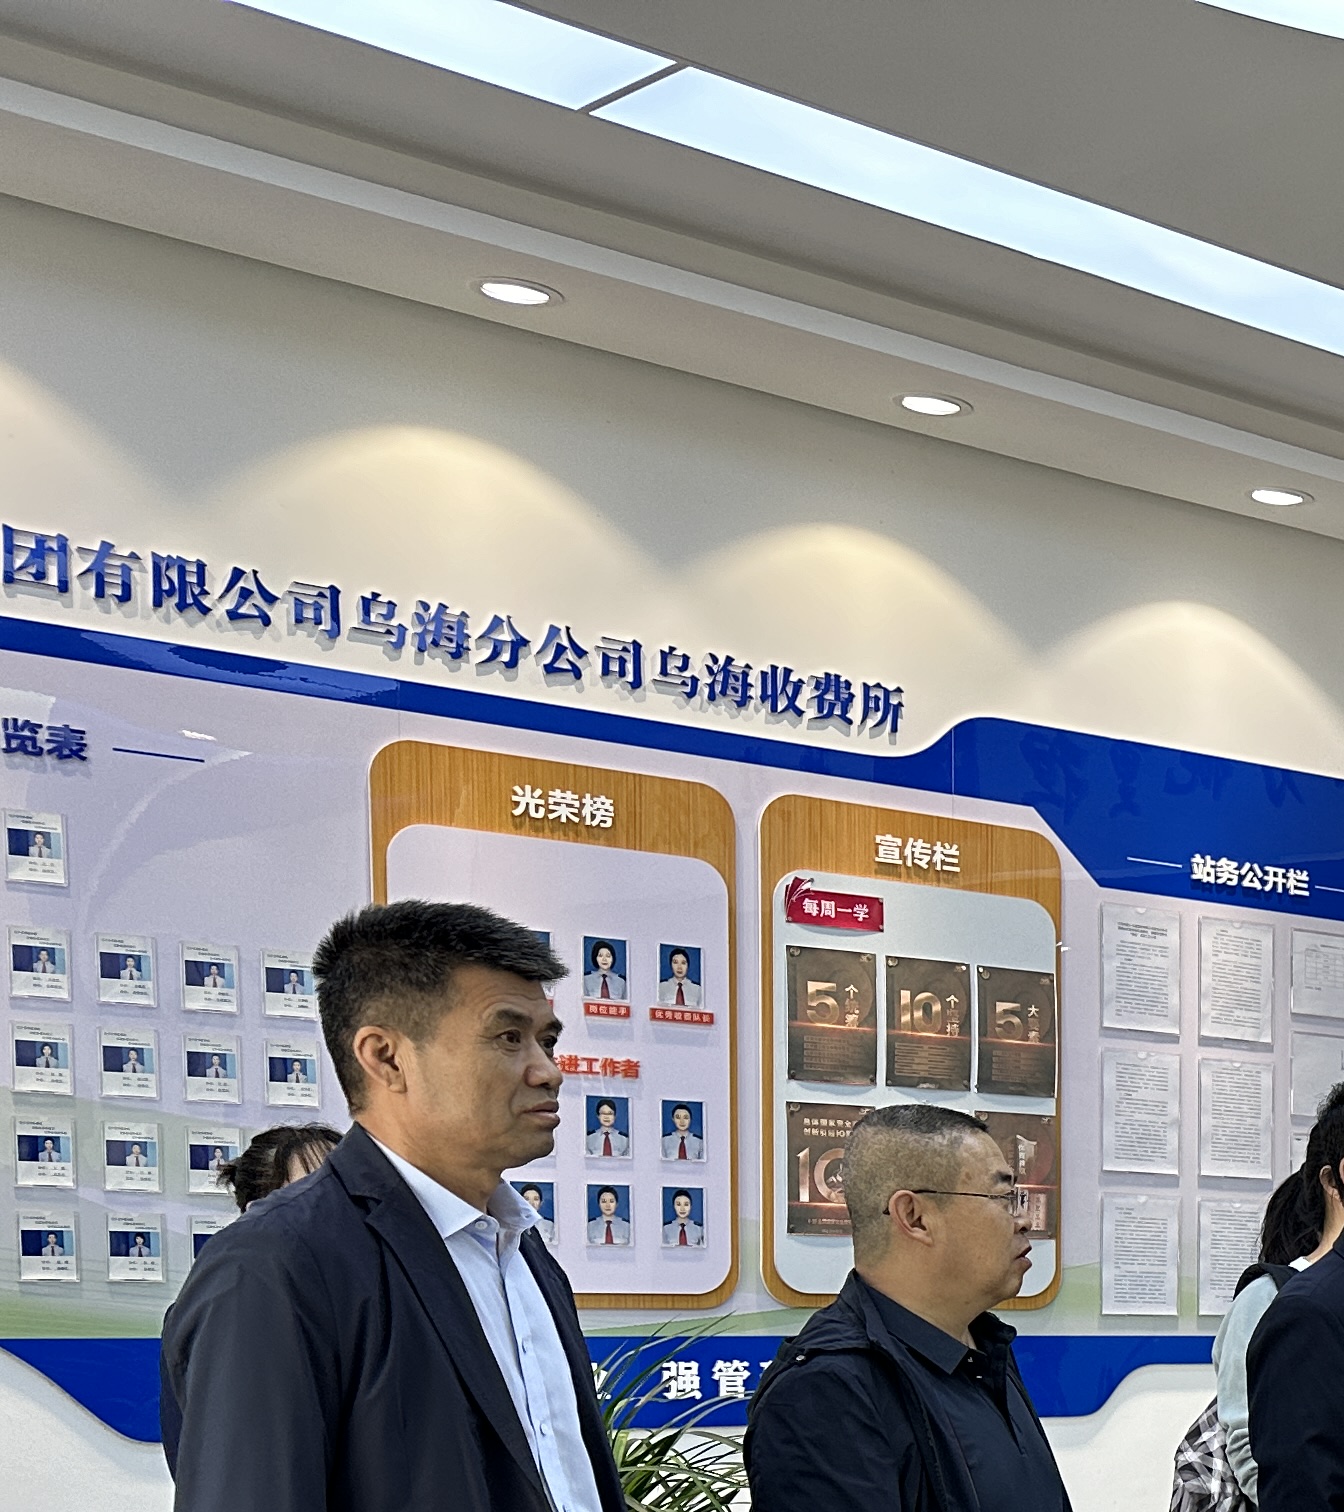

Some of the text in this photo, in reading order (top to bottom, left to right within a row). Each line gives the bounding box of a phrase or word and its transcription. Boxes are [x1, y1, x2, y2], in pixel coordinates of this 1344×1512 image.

[2, 523, 905, 735] 团有限公司乌海分公司乌海收费所
[1, 717, 88, 762] 览表
[511, 784, 615, 829] 光荣榜
[874, 833, 961, 873] 宣传栏
[1190, 853, 1311, 897] 站务公开栏
[802, 897, 870, 922] 每周一学
[806, 980, 840, 1025] 5
[900, 989, 942, 1034] 10
[995, 1001, 1024, 1041] 5
[554, 1054, 641, 1079] 进工作者
[661, 1360, 774, 1400] 强管
